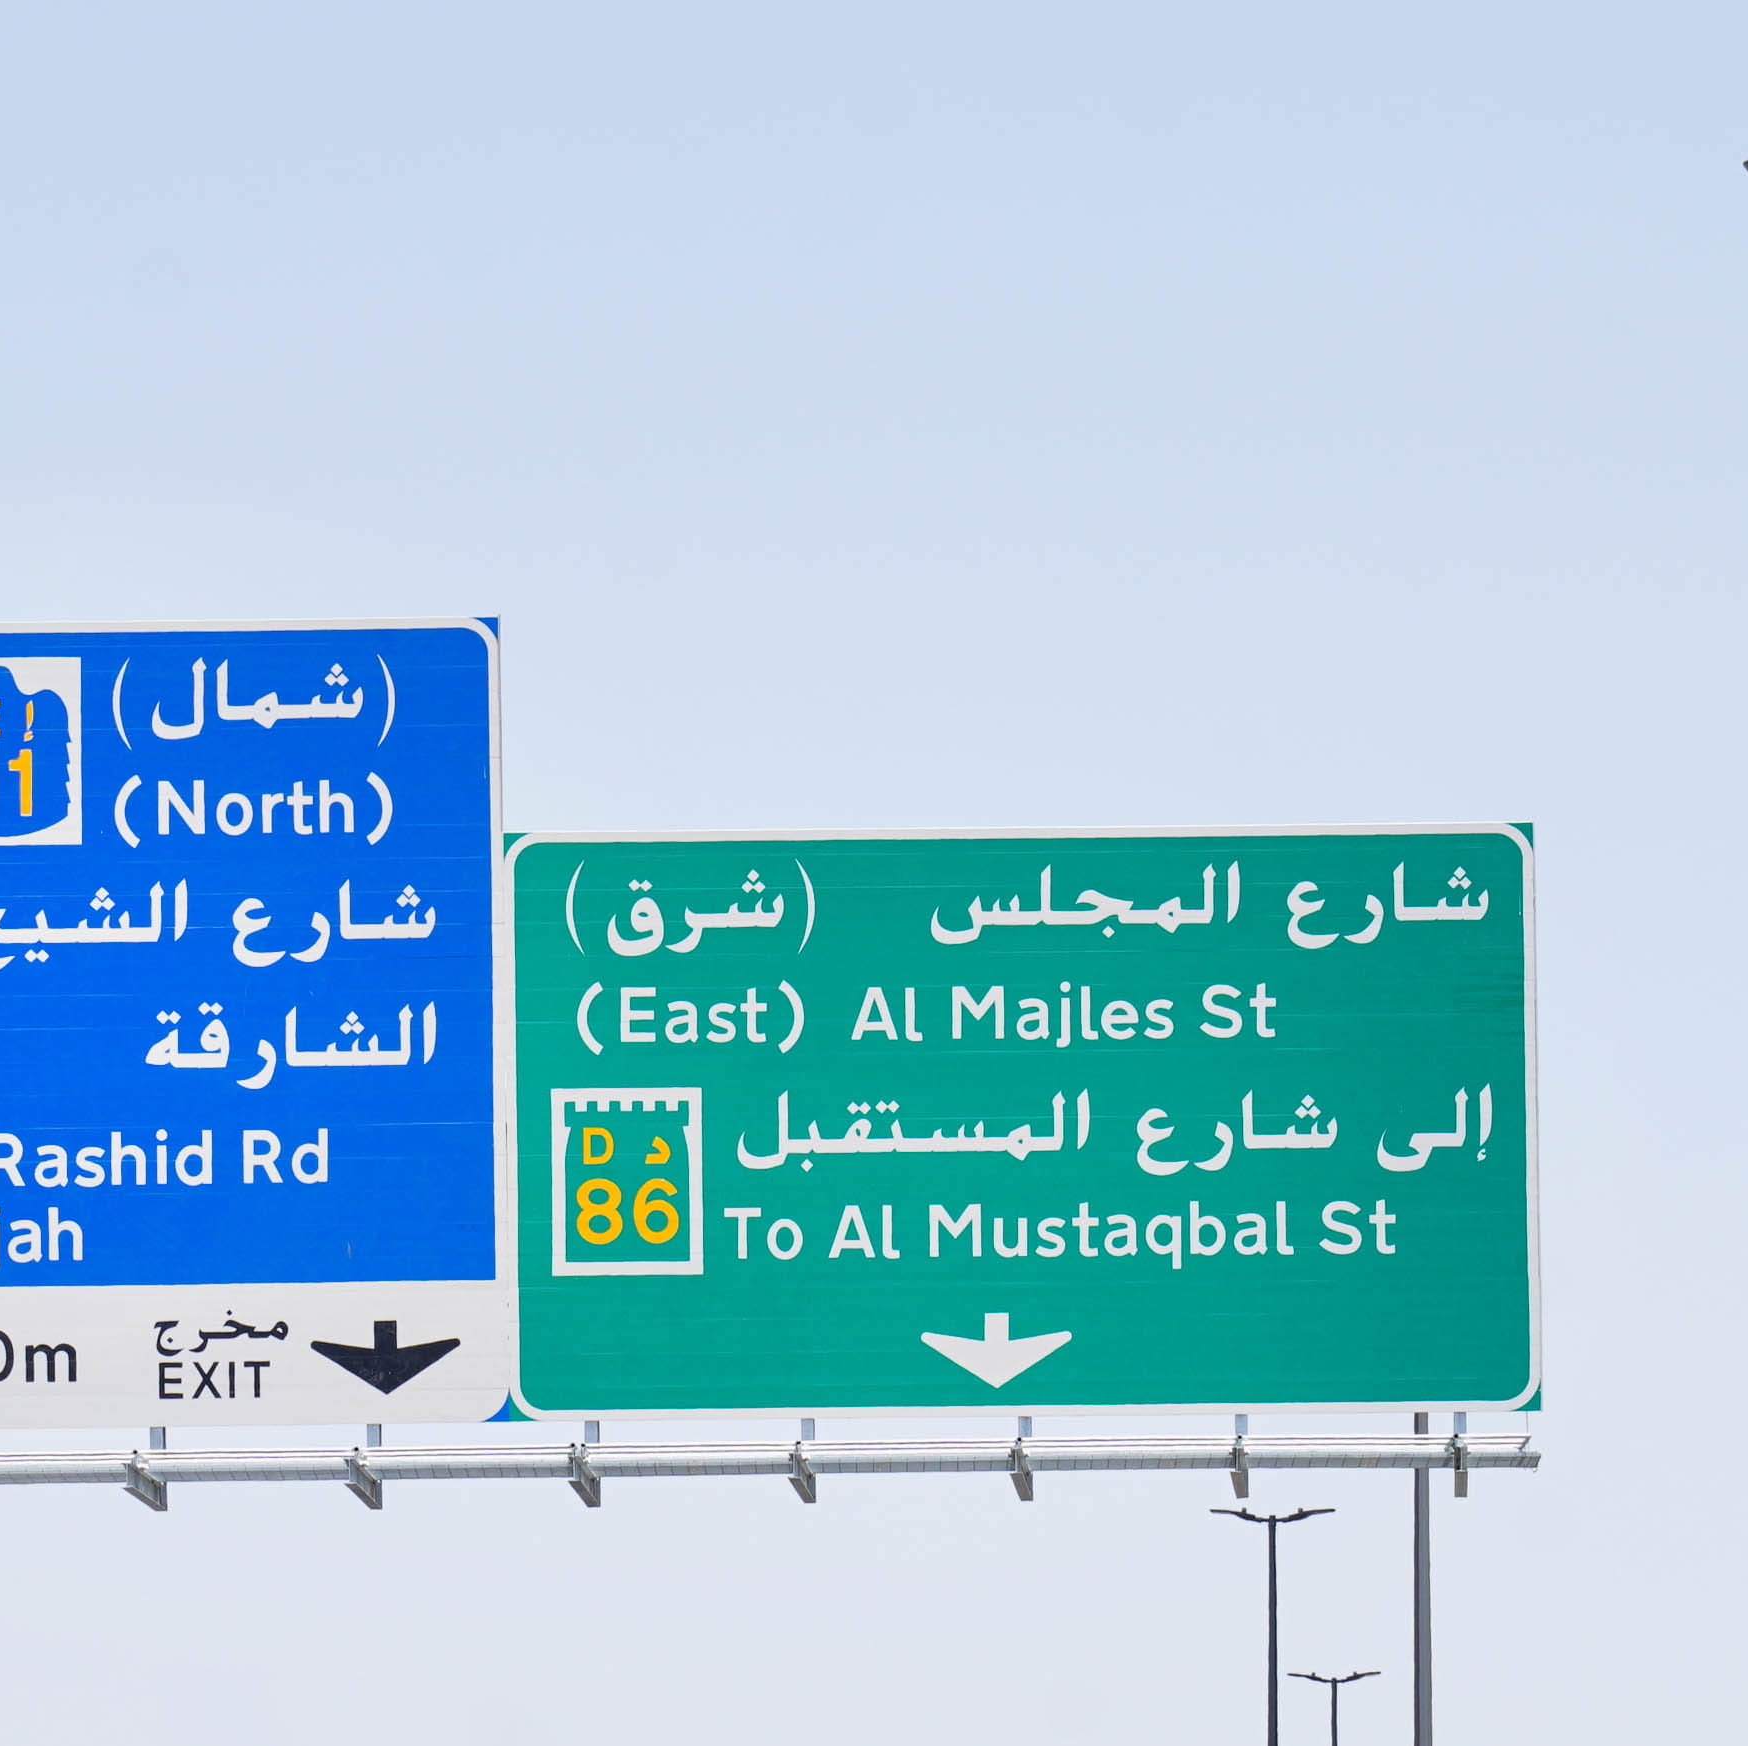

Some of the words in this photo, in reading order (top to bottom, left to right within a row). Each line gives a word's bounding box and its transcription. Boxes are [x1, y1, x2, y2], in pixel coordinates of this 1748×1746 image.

[113, 655, 395, 749] (شمال)
[115, 772, 392, 848] (North)
[233, 880, 435, 967] شارع
[566, 861, 815, 956] (شرق)
[931, 861, 1240, 944] المجلس
[1287, 863, 1488, 949] شارع
[146, 1002, 436, 1089] الشارقة
[577, 981, 804, 1055] (East)
[852, 987, 922, 1041] Al
[952, 982, 1173, 1047] Majles
[1200, 984, 1276, 1038] St
[243, 1128, 328, 1184] Rd
[582, 1127, 614, 1165] D
[738, 1090, 1089, 1171] المستقبل
[1137, 1091, 1337, 1175] شارع
[1377, 1084, 1492, 1171] إلى
[576, 1178, 680, 1245] 86
[724, 1208, 803, 1260] To
[829, 1205, 900, 1259] Al
[929, 1201, 1294, 1269] Mustaqbal
[1320, 1200, 1396, 1254] St
[154, 1310, 289, 1355] مخرج
[159, 1361, 270, 1398] EXIT
